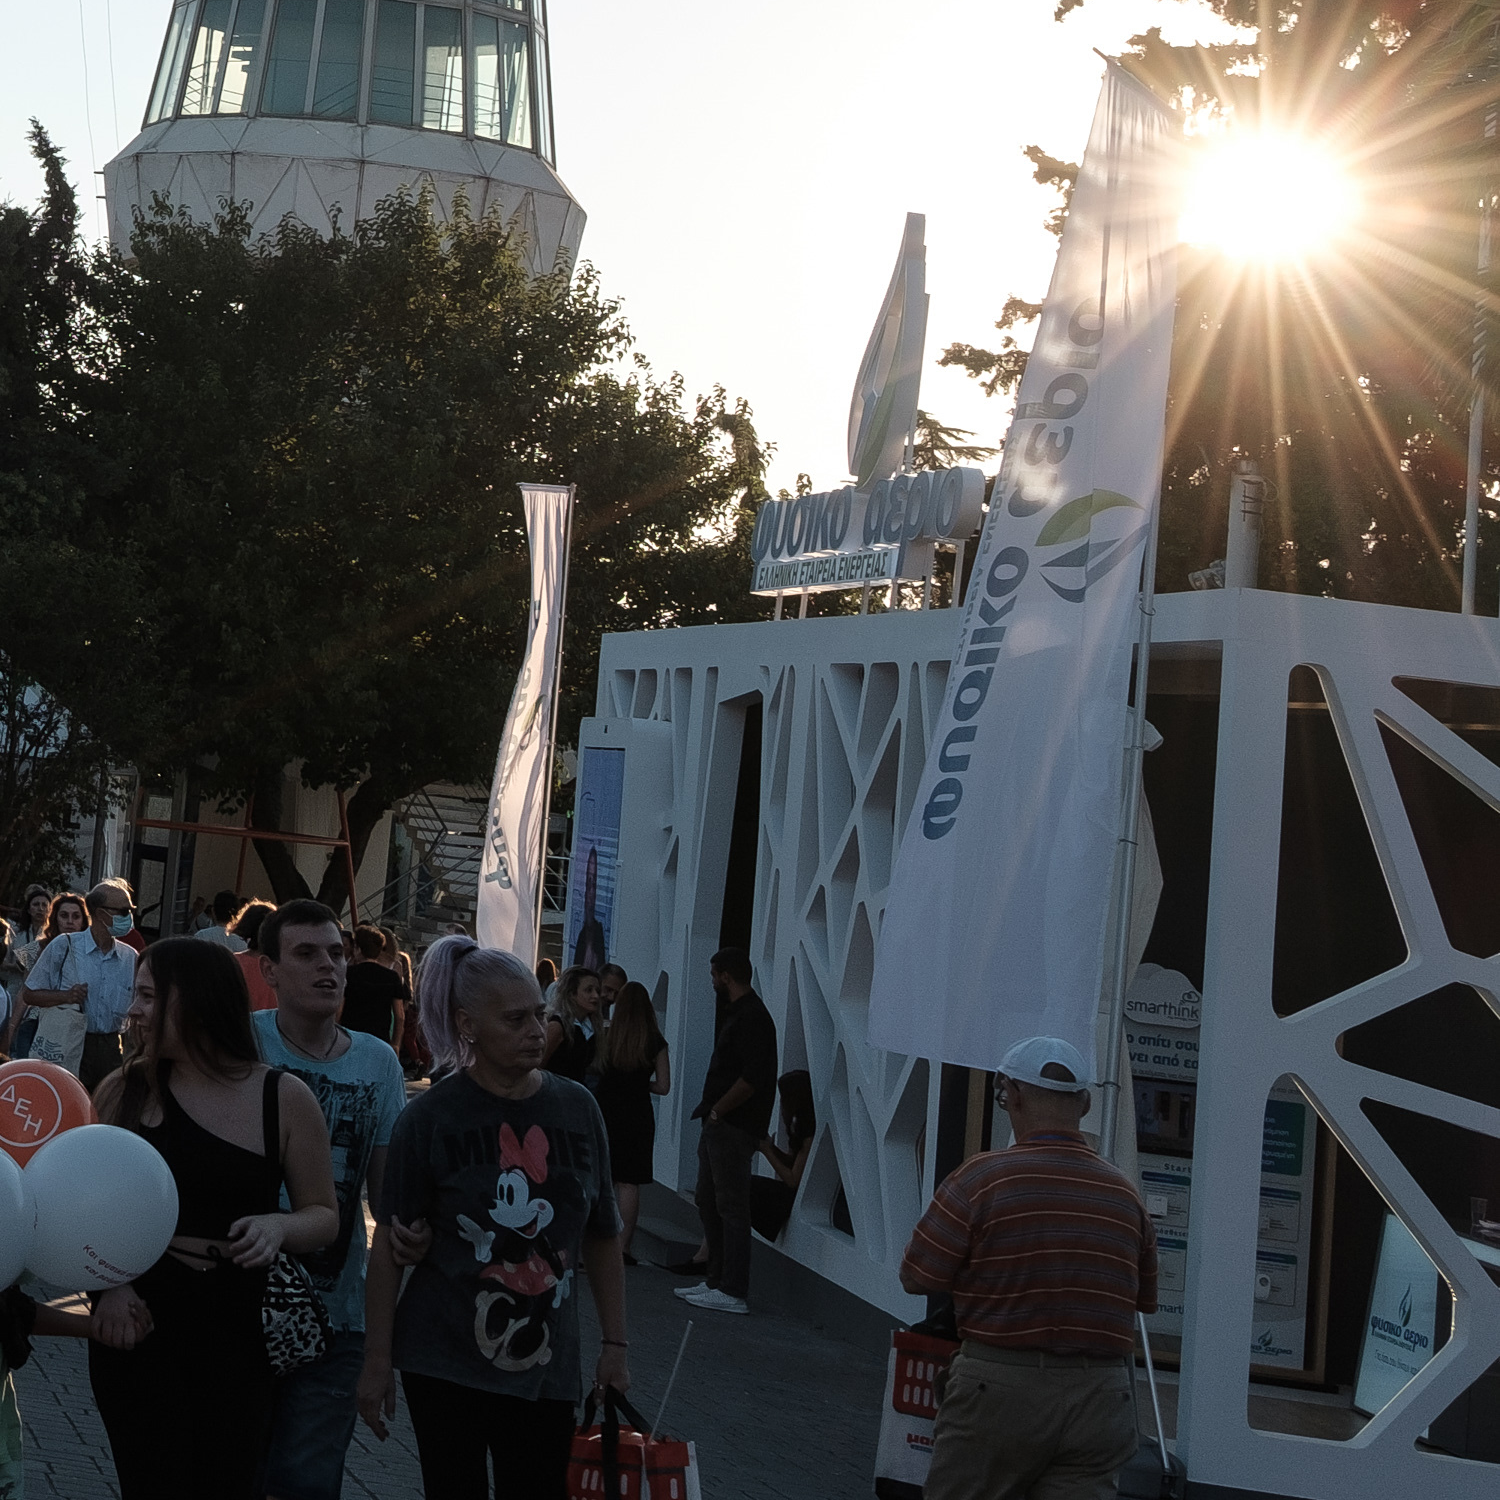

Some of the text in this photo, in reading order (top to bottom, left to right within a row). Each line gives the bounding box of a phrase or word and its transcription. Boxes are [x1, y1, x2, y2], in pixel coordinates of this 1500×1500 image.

[758, 551, 889, 590] ΕΛΛΗΝΙΚΗ ΕΤΑΙΡΕΙΑ ΕΝΕΡΓΕΙΑΣ
[1126, 1000, 1199, 1019] smarthink
[1138, 1033, 1171, 1048] σπίτι
[1129, 1051, 1149, 1063] νει
[1152, 1053, 1180, 1067] από
[0, 1084, 42, 1136] ΔΕΗ
[442, 1125, 592, 1172] MIIE
[83, 1244, 99, 1260] Και
